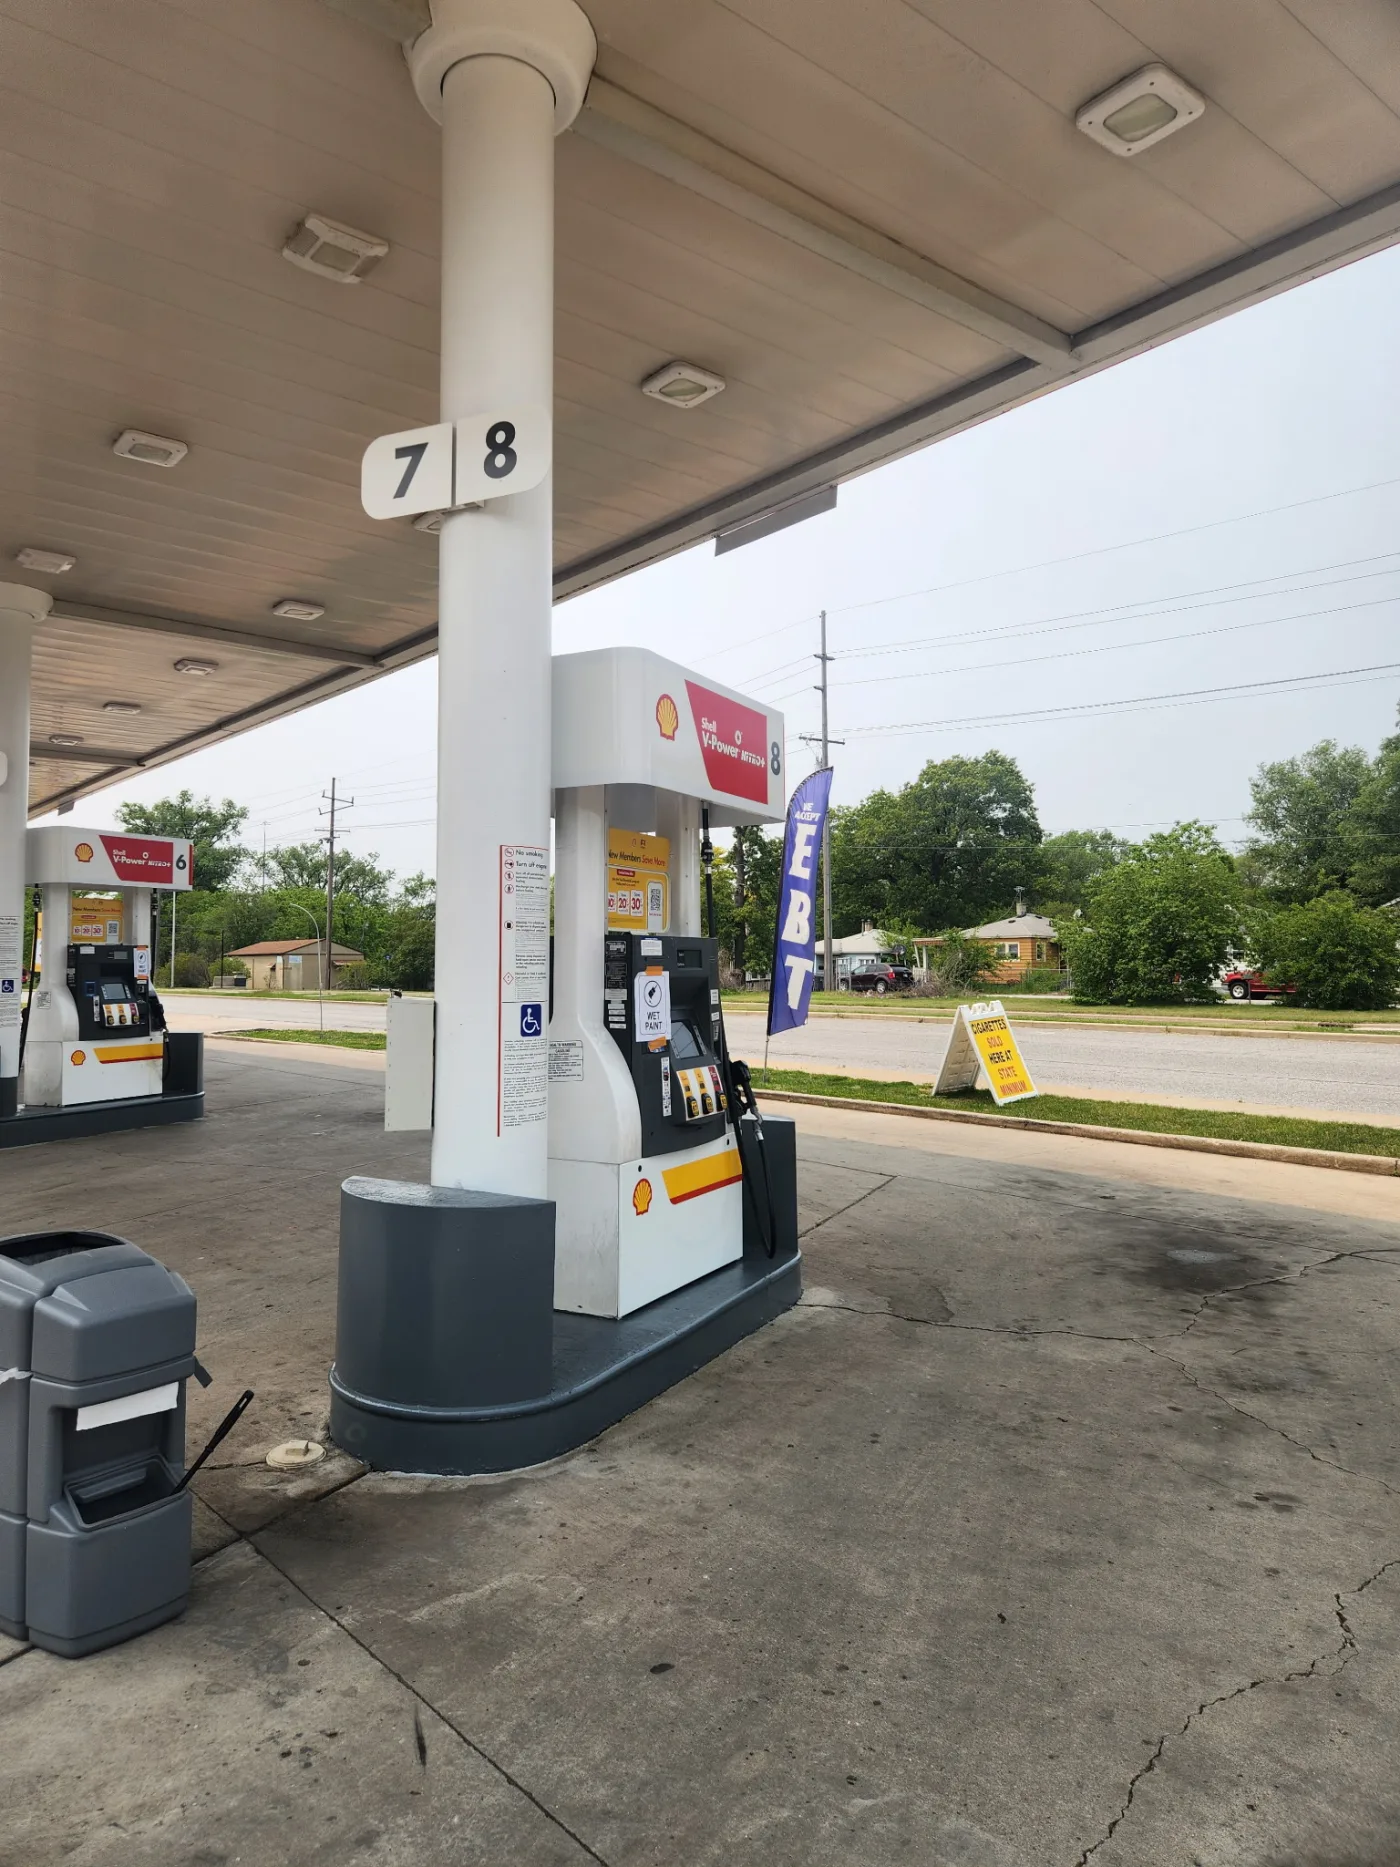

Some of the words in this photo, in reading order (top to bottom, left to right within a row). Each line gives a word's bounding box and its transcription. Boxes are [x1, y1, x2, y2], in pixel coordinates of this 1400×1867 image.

[484, 421, 517, 479] 8
[393, 442, 429, 499] 7
[701, 717, 717, 733] Shell
[702, 731, 739, 758] V-Power
[770, 741, 781, 776] 8
[794, 810, 822, 822] ACCEPT
[112, 855, 145, 866] V-Power
[175, 854, 187, 871] 6
[646, 1011, 660, 1020] WET
[645, 1021, 662, 1031] PAINT
[971, 1018, 1007, 1034] CIGARETTES
[986, 1035, 1004, 1048] SOLD
[988, 1051, 1005, 1064] HERE
[1005, 1050, 1012, 1061] AT
[998, 1066, 1017, 1079] STATE
